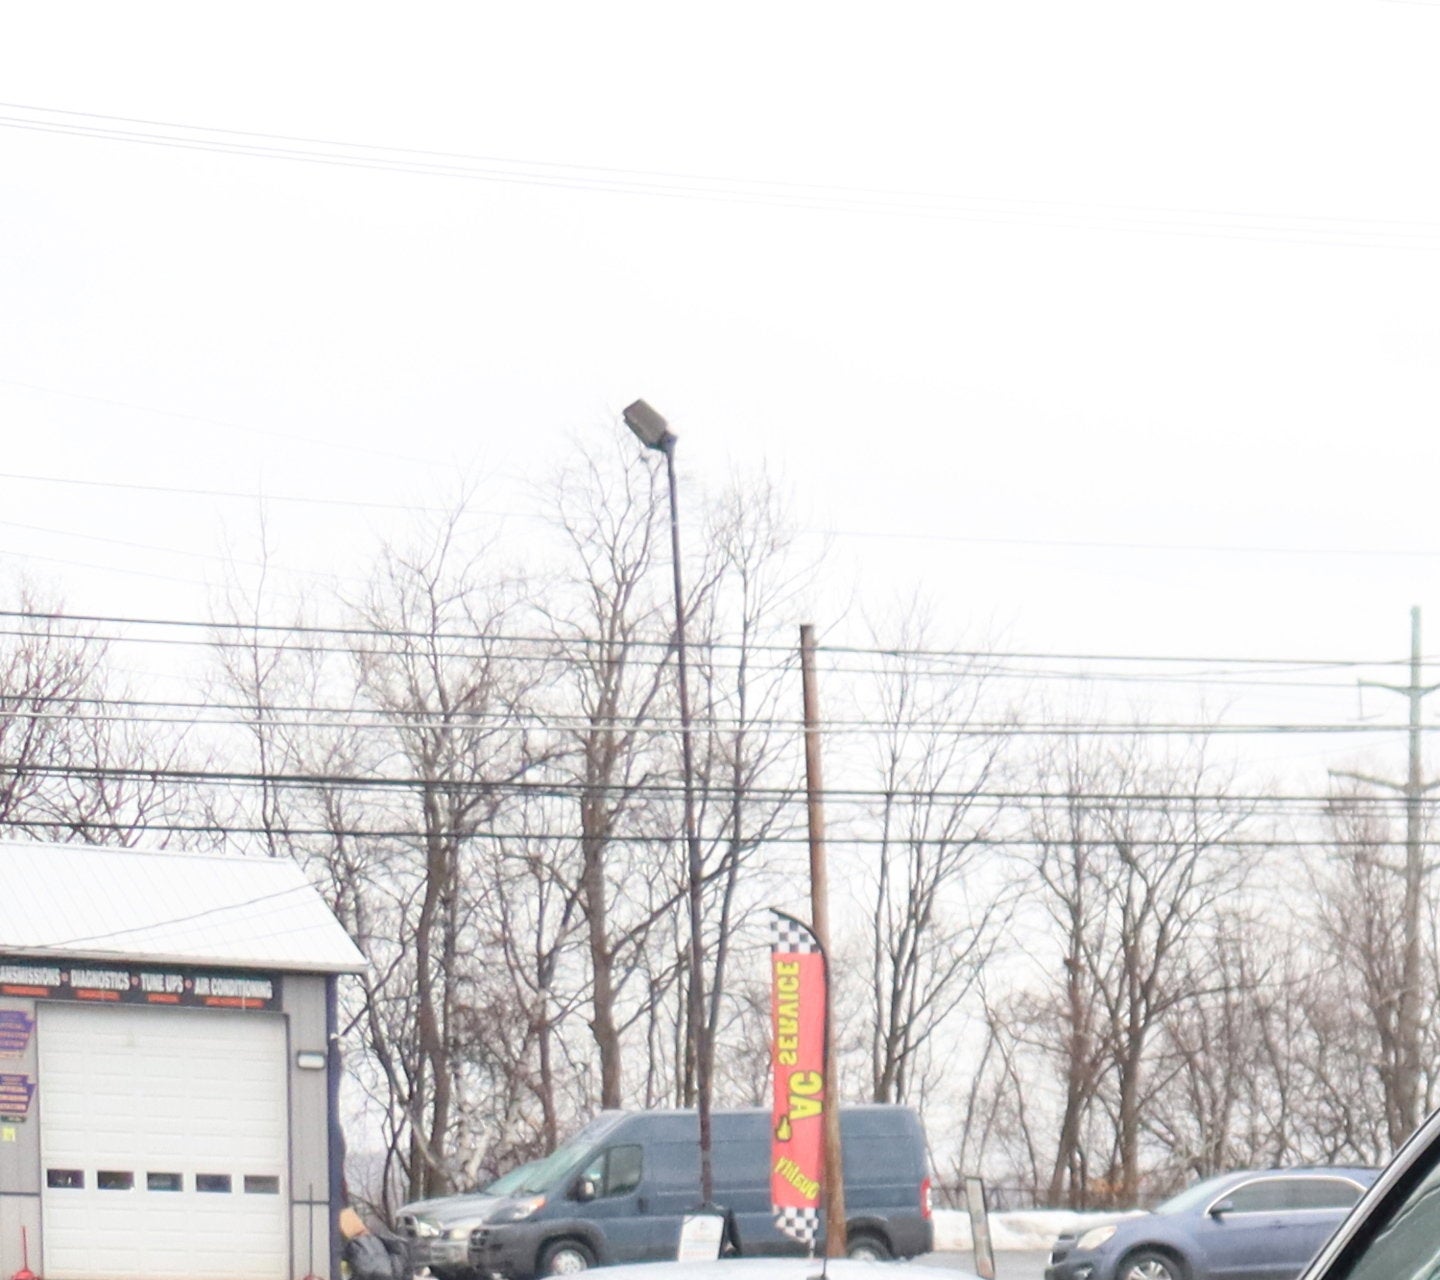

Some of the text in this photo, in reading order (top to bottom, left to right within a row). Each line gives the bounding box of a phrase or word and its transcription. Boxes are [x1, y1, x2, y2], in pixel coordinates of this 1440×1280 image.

[71, 969, 130, 990] DIAGNOSTICS
[141, 973, 164, 992] TUNE
[165, 975, 184, 993] UPS
[211, 978, 273, 999] CONDITIONING
